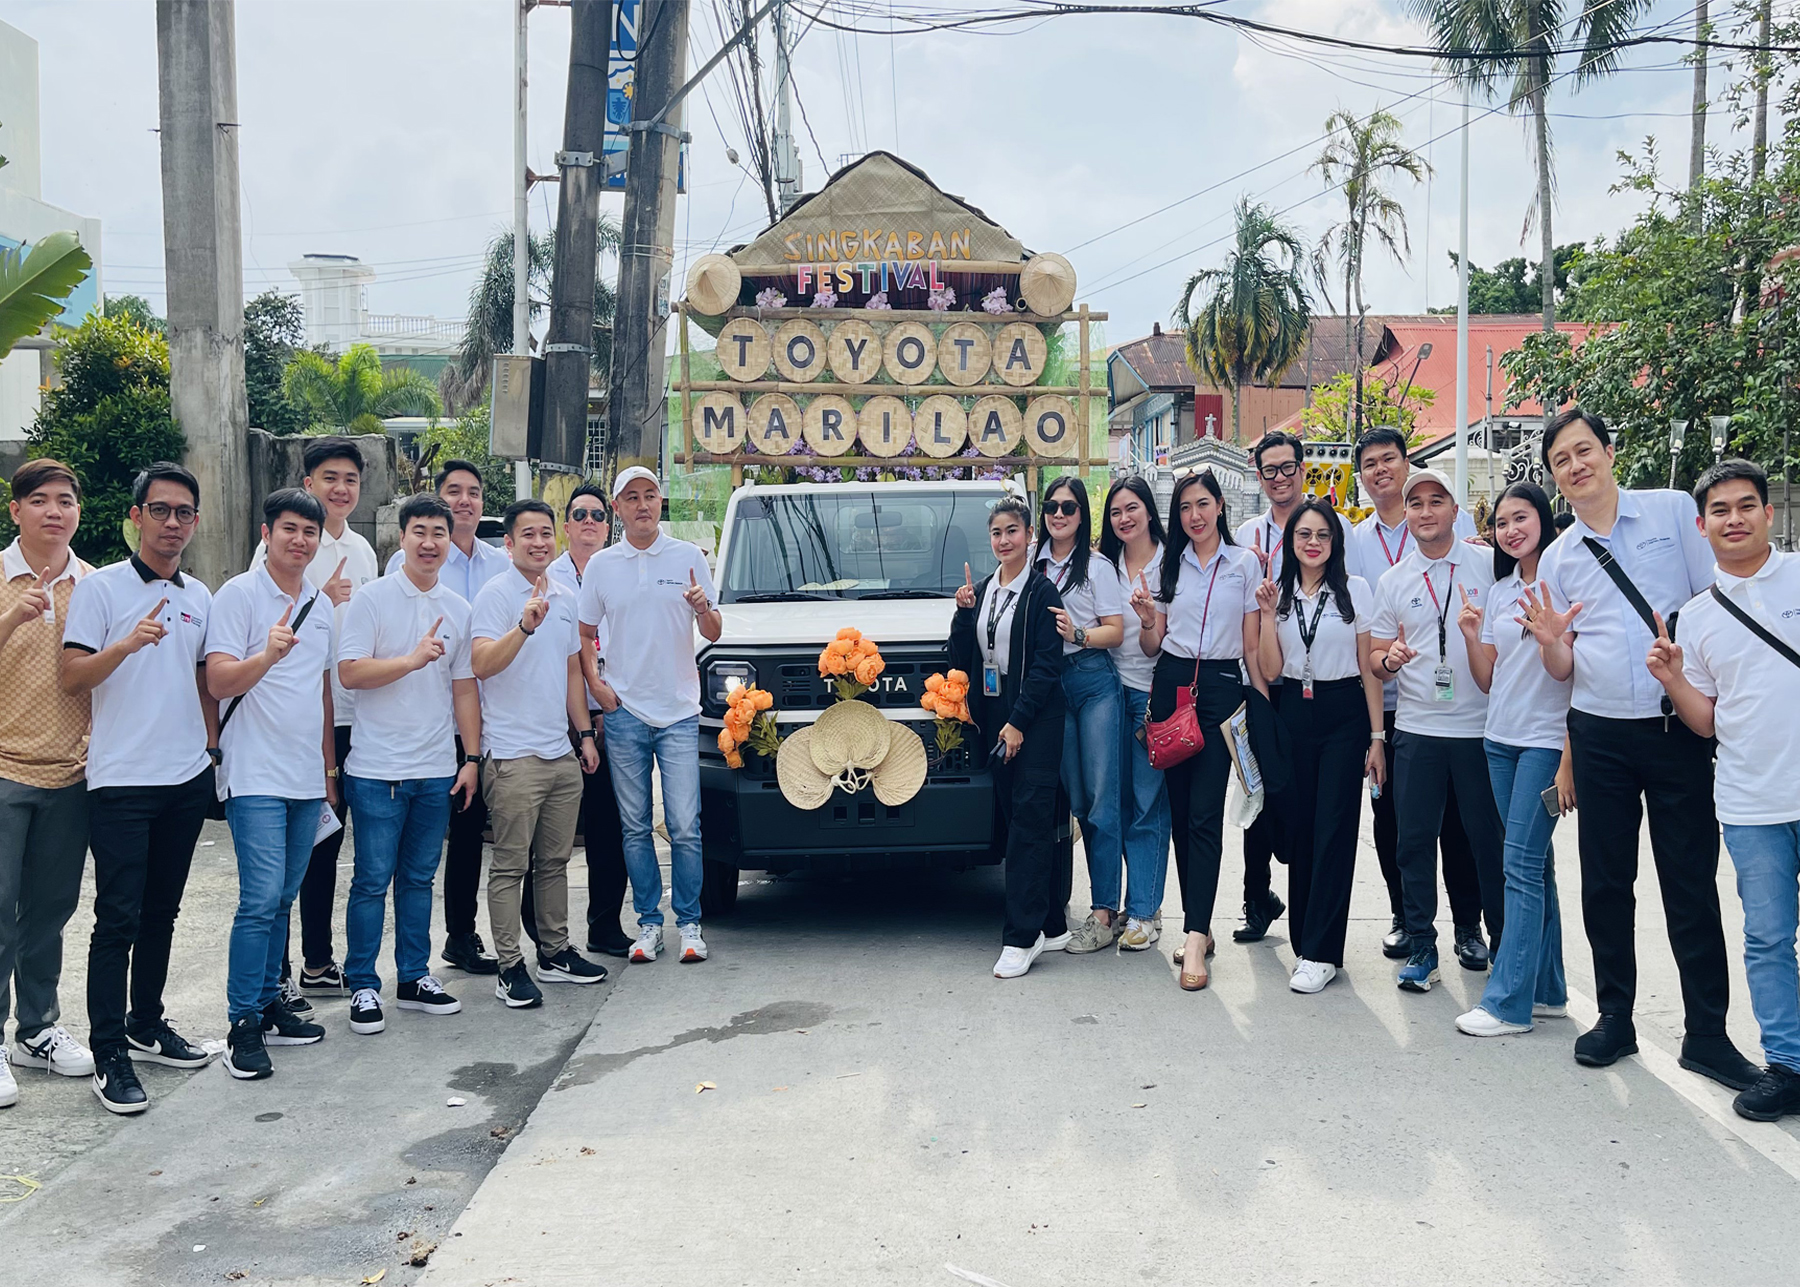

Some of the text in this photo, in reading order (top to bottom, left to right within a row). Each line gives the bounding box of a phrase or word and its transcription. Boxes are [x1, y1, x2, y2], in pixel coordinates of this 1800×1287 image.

[783, 228, 971, 262] SINGKABAN
[798, 260, 945, 294] FESTIVAL
[732, 334, 1032, 371] TOYOTA
[703, 406, 1066, 444] MARILAO
[823, 676, 908, 693] TOTA
